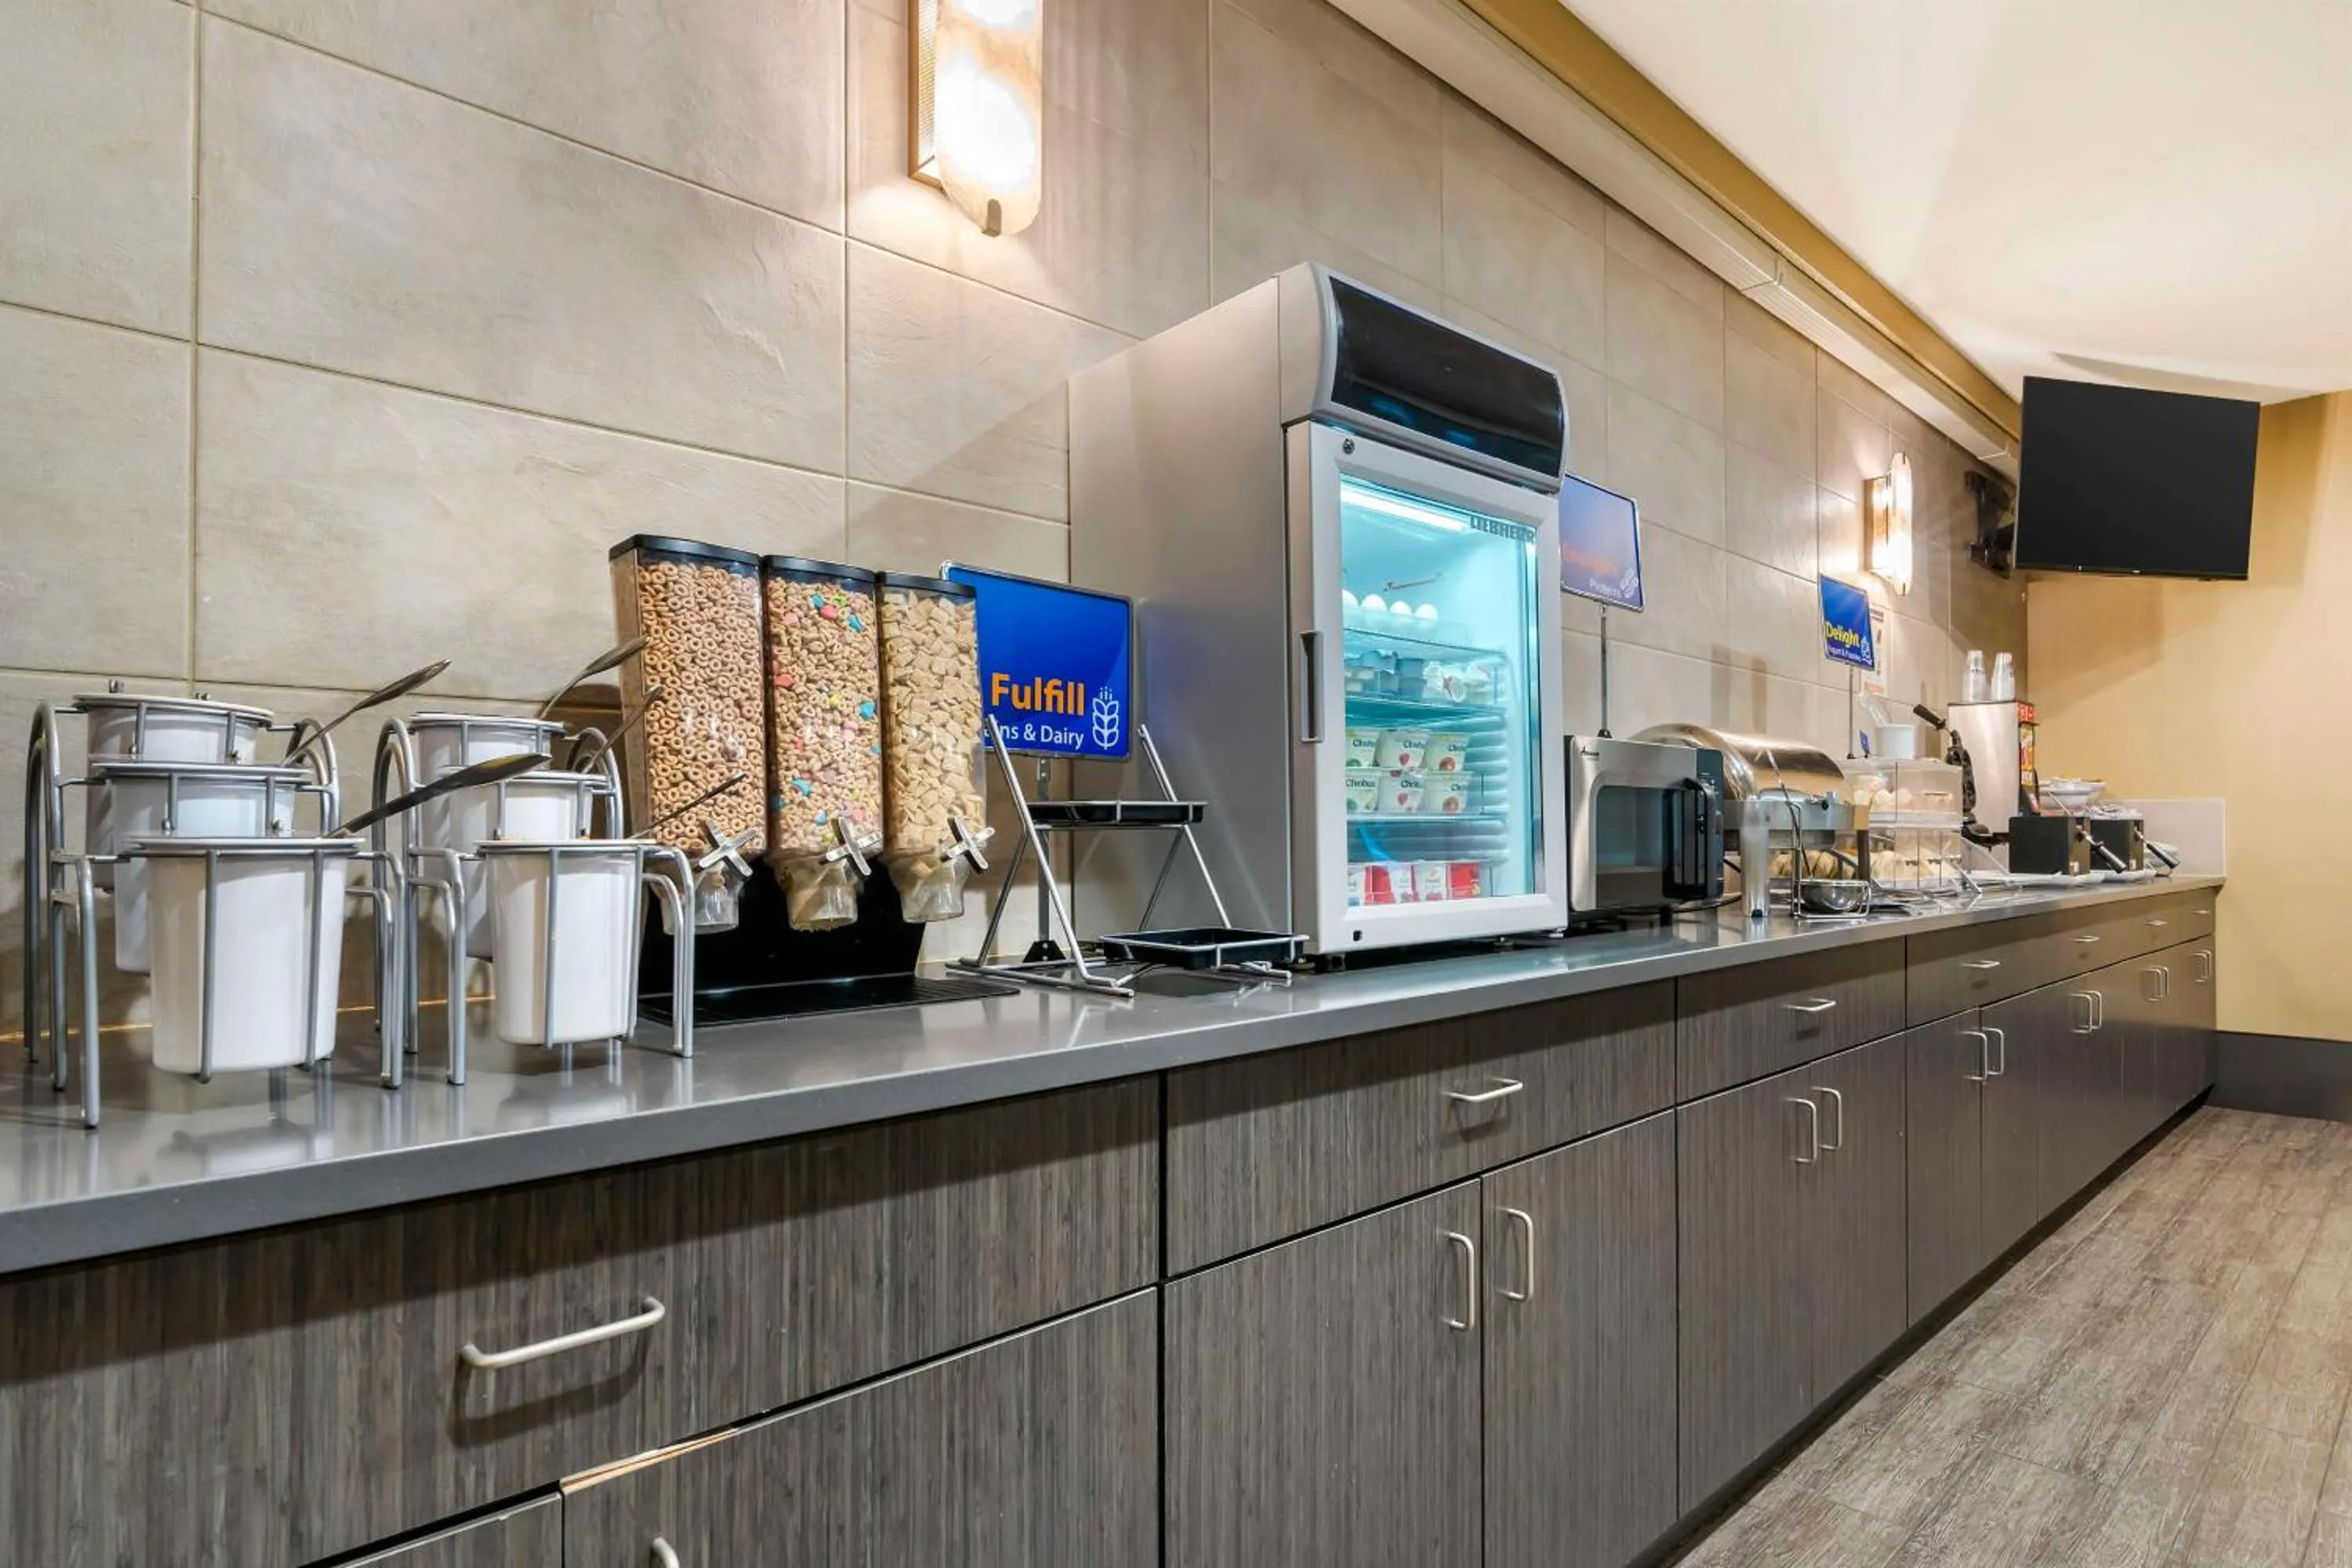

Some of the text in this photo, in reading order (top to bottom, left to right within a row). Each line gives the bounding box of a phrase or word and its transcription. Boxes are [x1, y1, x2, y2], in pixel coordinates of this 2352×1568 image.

[991, 672, 1085, 717] Fulfill
[1023, 723, 1036, 741] &
[1040, 724, 1084, 751] Dairy
